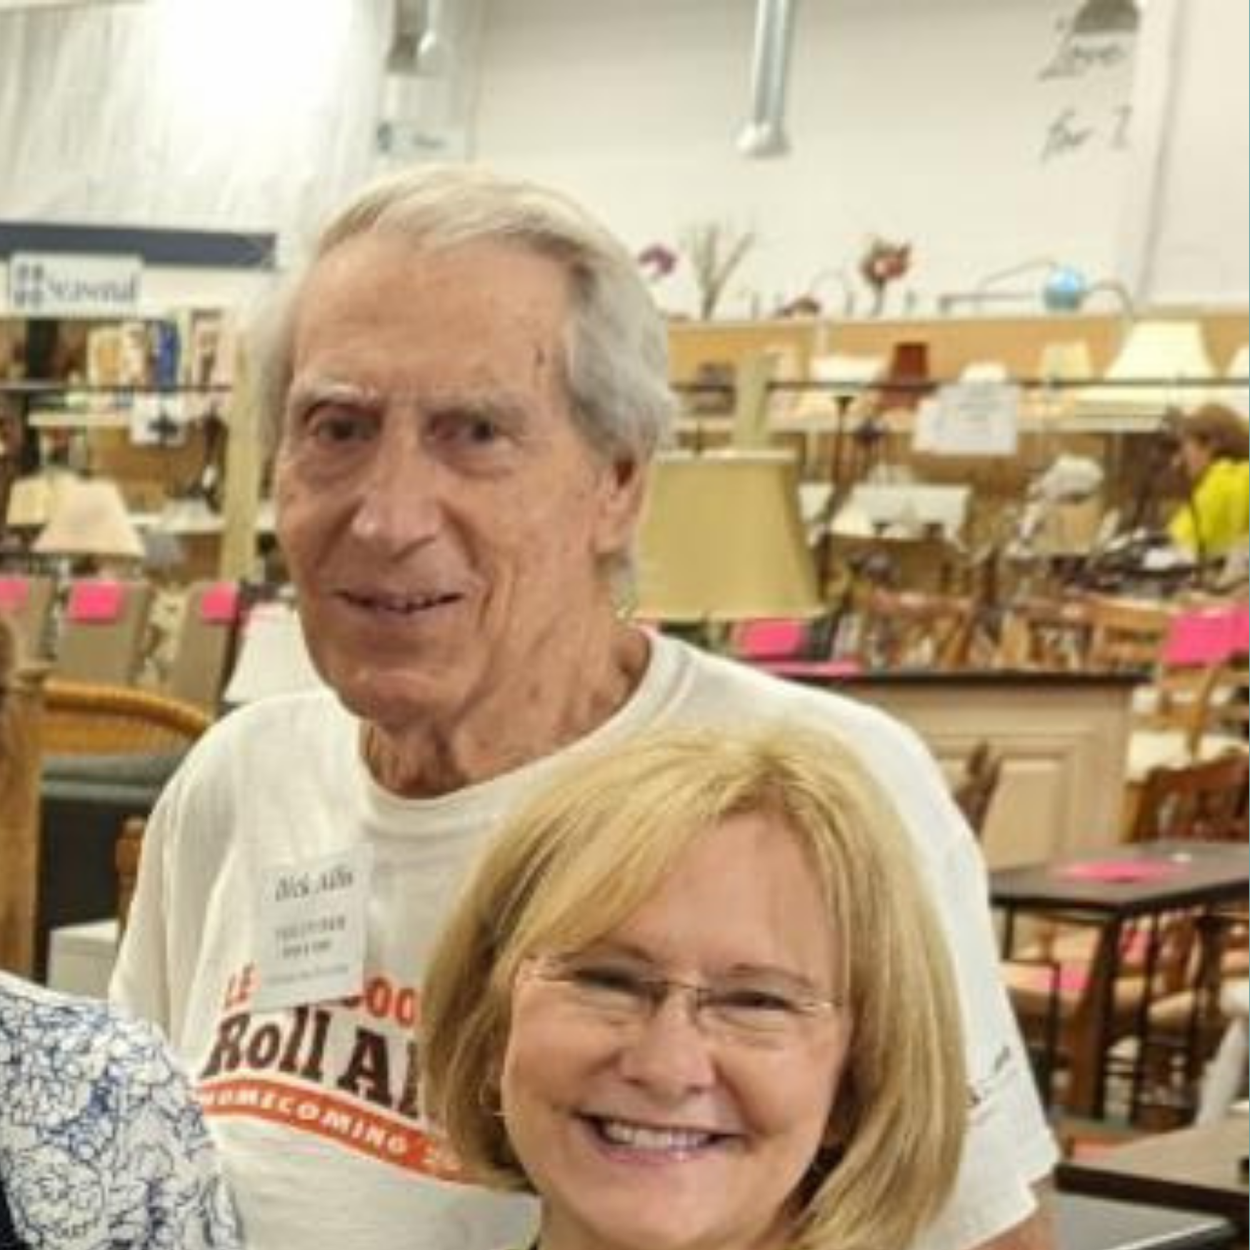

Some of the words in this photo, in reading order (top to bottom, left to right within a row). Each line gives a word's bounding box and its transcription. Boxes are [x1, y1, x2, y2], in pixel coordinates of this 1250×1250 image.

[225, 962, 259, 1009] LE
[365, 976, 416, 1027] OO
[201, 1004, 331, 1082] Roll
